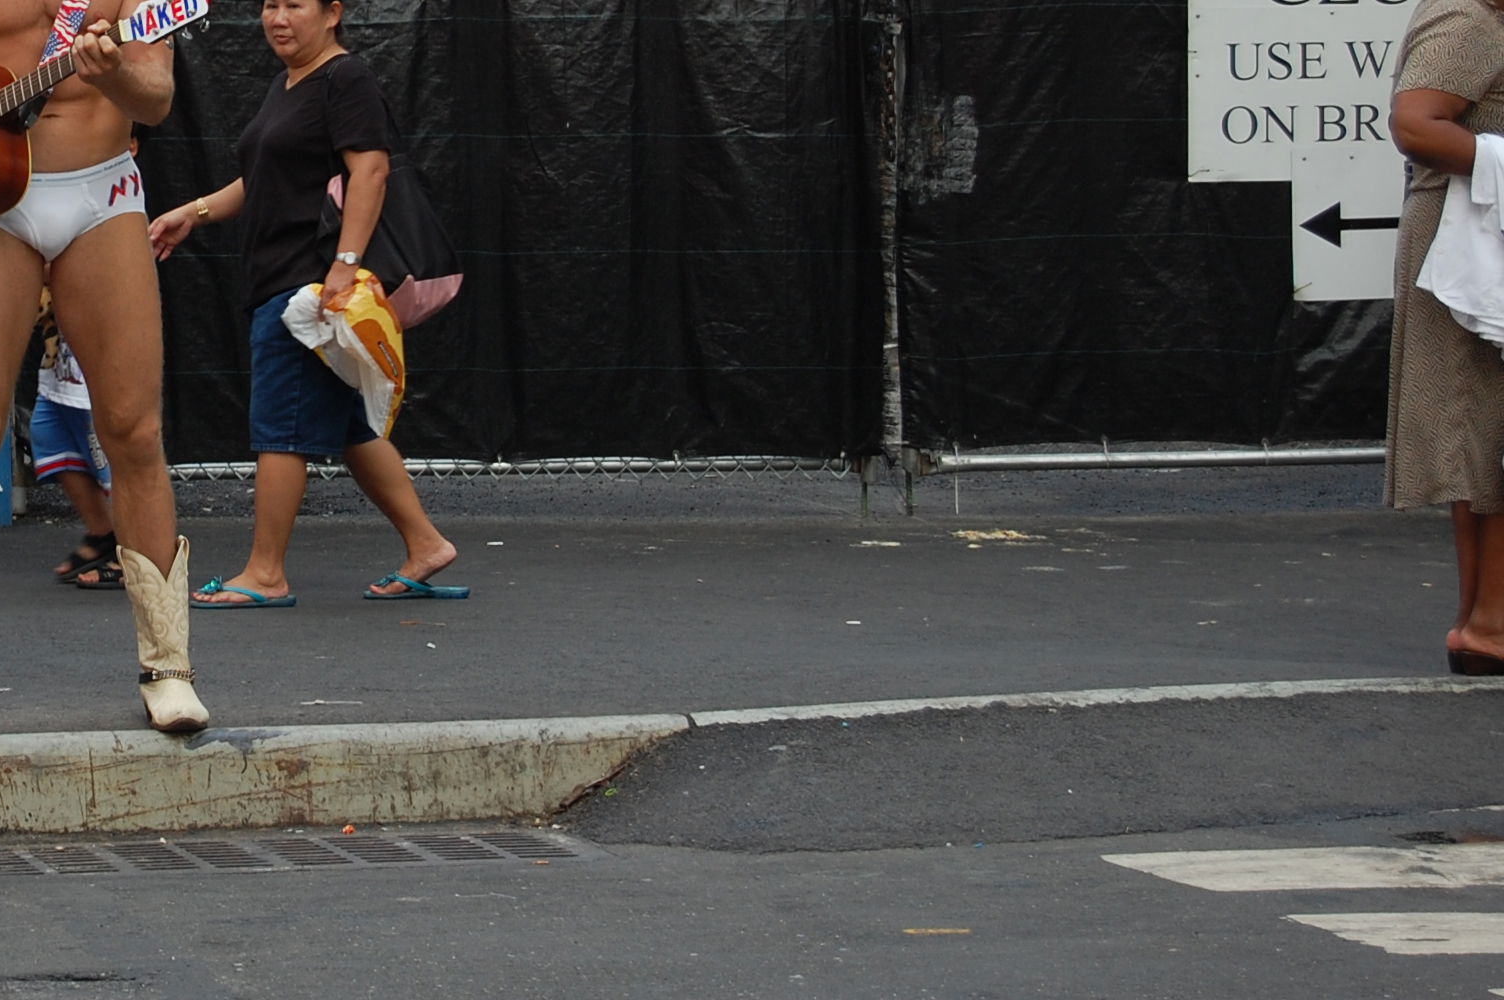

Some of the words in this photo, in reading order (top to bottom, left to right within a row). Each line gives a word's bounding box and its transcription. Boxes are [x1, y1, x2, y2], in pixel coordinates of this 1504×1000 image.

[1225, 41, 1328, 82] USE
[1344, 40, 1398, 80] W
[1221, 104, 1299, 145] ON
[1314, 103, 1394, 144] BR
[108, 170, 140, 207] NY
